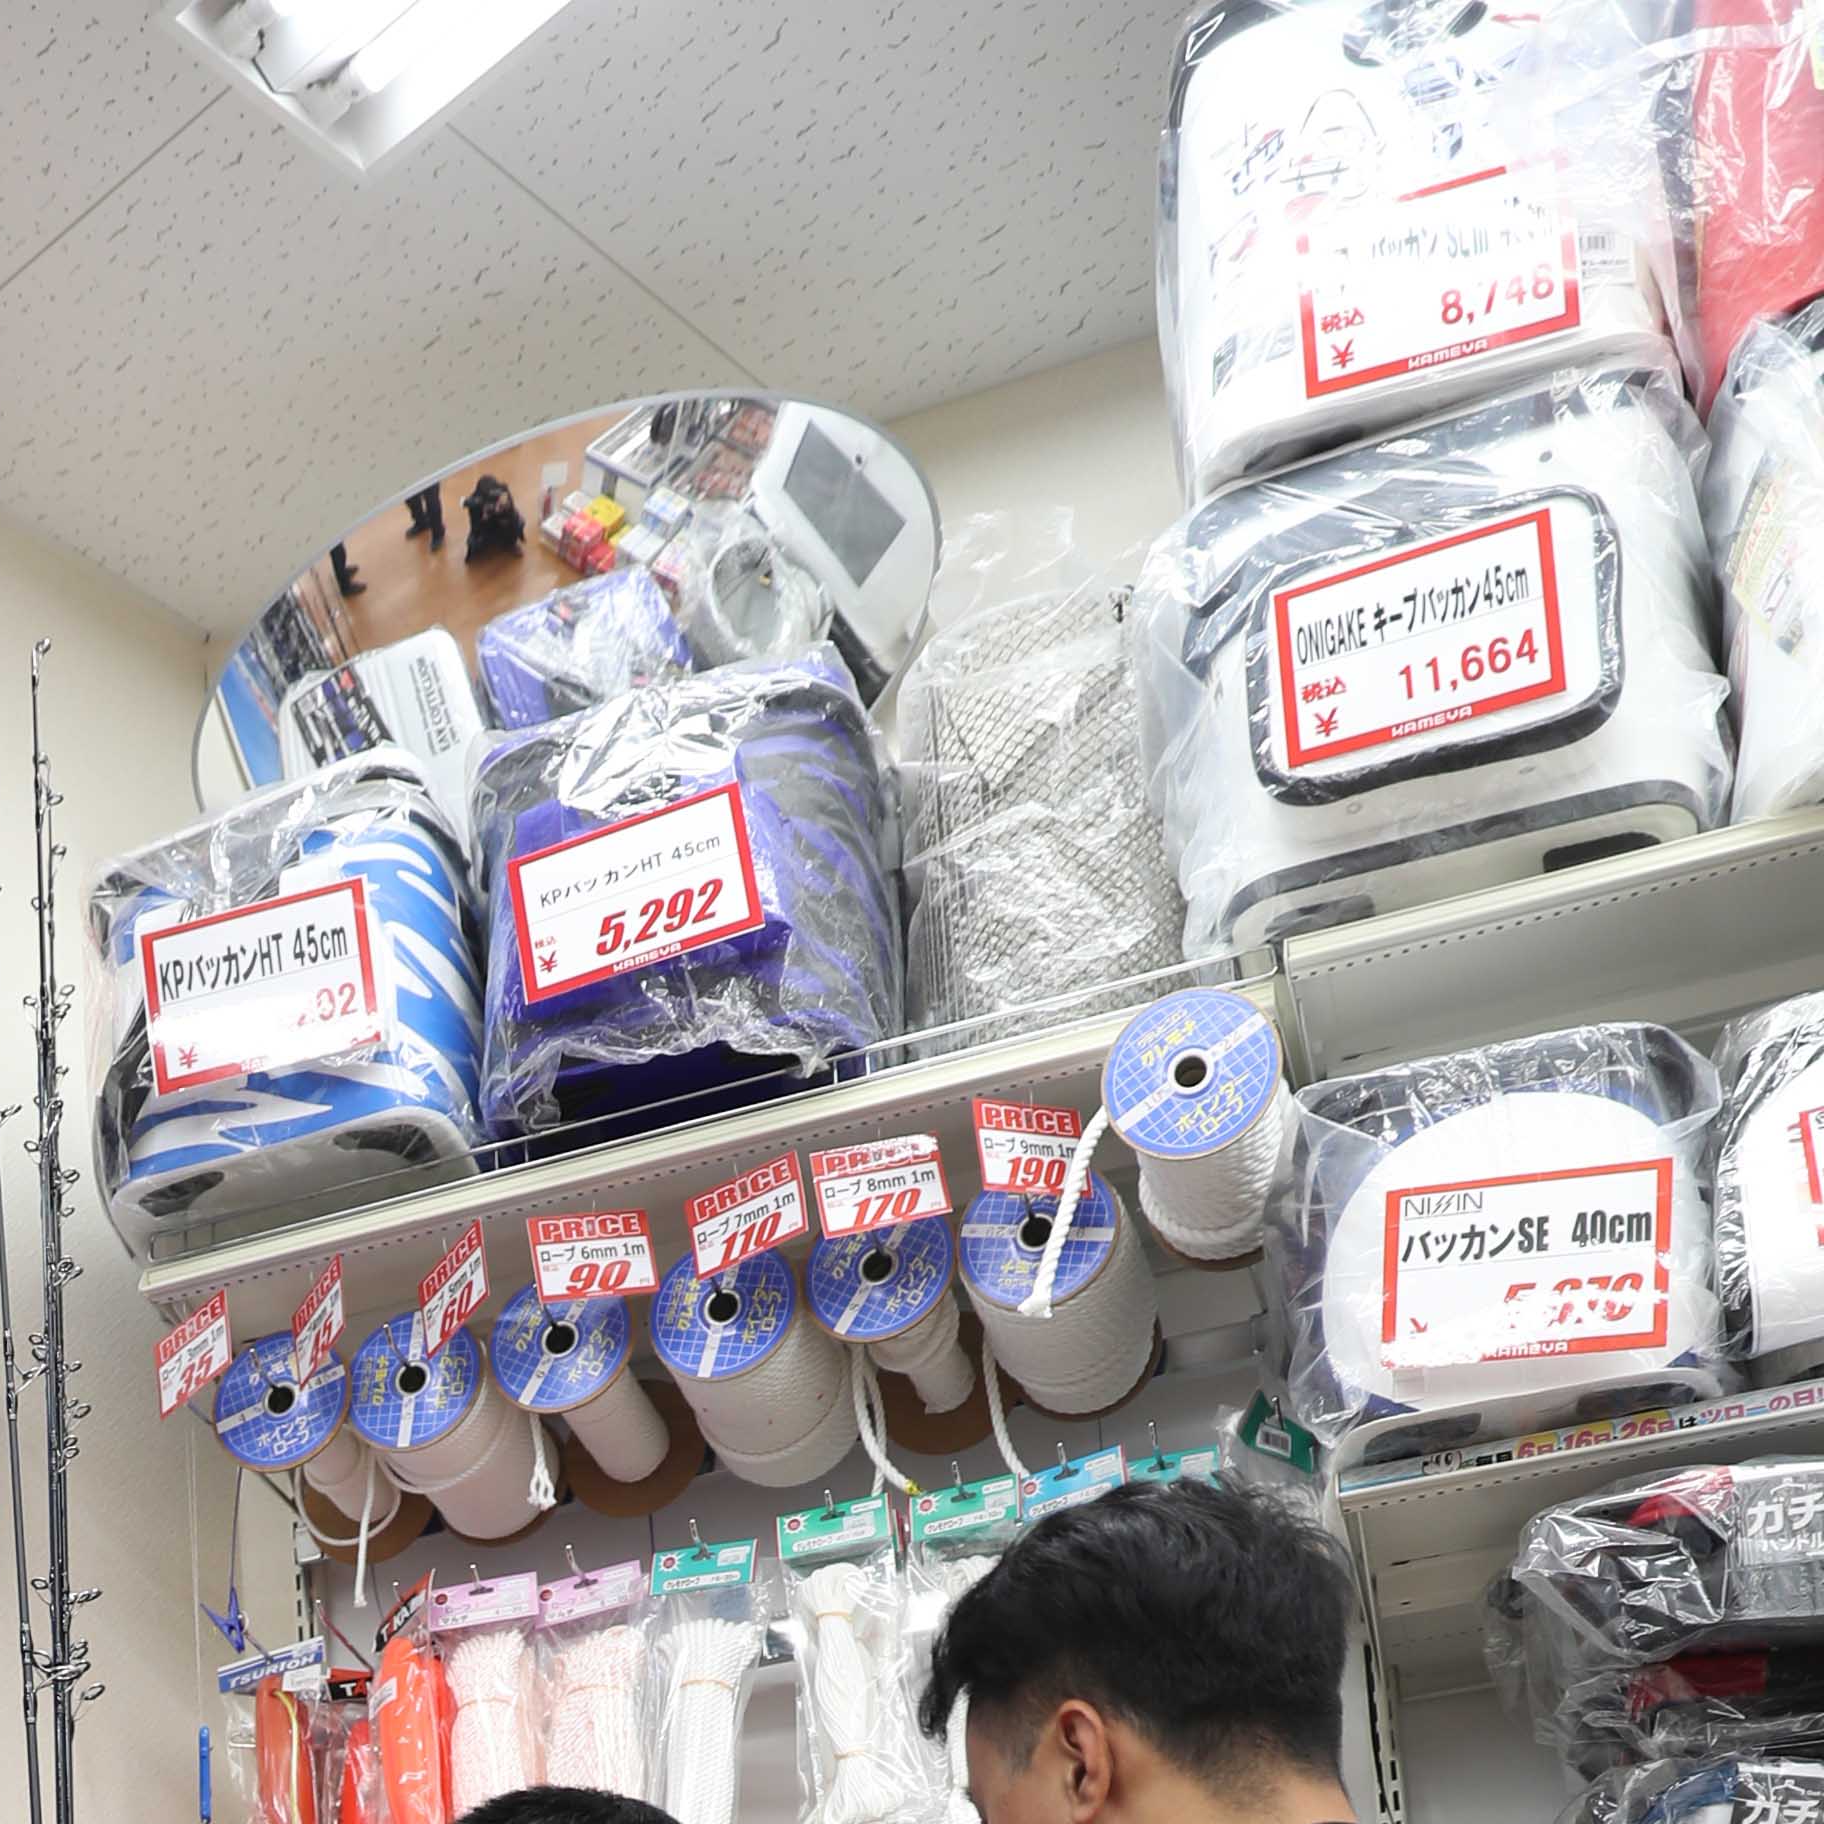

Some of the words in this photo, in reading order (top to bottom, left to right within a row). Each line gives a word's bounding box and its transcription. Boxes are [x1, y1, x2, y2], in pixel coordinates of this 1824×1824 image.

[1297, 604, 1368, 665] ONIGAKE
[1373, 563, 1530, 648] キープバッカン45cm
[1397, 627, 1540, 702] 11,664
[1301, 676, 1347, 704] 税込
[670, 832, 722, 864] 45cm
[594, 877, 721, 958] 5,292
[159, 930, 285, 1004] KPバッカンHT
[291, 923, 350, 968] 45cm
[981, 1102, 1074, 1136] PRICE
[984, 1138, 1017, 1155] ロープ
[1019, 1139, 1057, 1159] 9mm
[696, 1159, 792, 1221] PRICE
[824, 1180, 862, 1200] ロープ
[866, 1174, 908, 1195] 8mm
[911, 1168, 937, 1185] 1m
[1005, 1157, 1066, 1189] 190
[735, 1205, 773, 1230] 7mm
[773, 1189, 796, 1210] 1m
[852, 1187, 922, 1228] 170
[1404, 1191, 1484, 1220] NISSIN
[540, 1212, 642, 1243] PRICE
[718, 1210, 782, 1268] 110
[1400, 1214, 1551, 1265] バッカンSE
[1571, 1207, 1653, 1248] 40cm
[422, 1226, 480, 1300] PRICE
[540, 1246, 576, 1263] ロープ
[580, 1243, 621, 1261] 6mm
[623, 1241, 647, 1258] 1m
[565, 1259, 632, 1298] 90
[159, 1297, 222, 1361] PRICE
[439, 1280, 474, 1340] 60
[176, 1346, 214, 1404] 35
